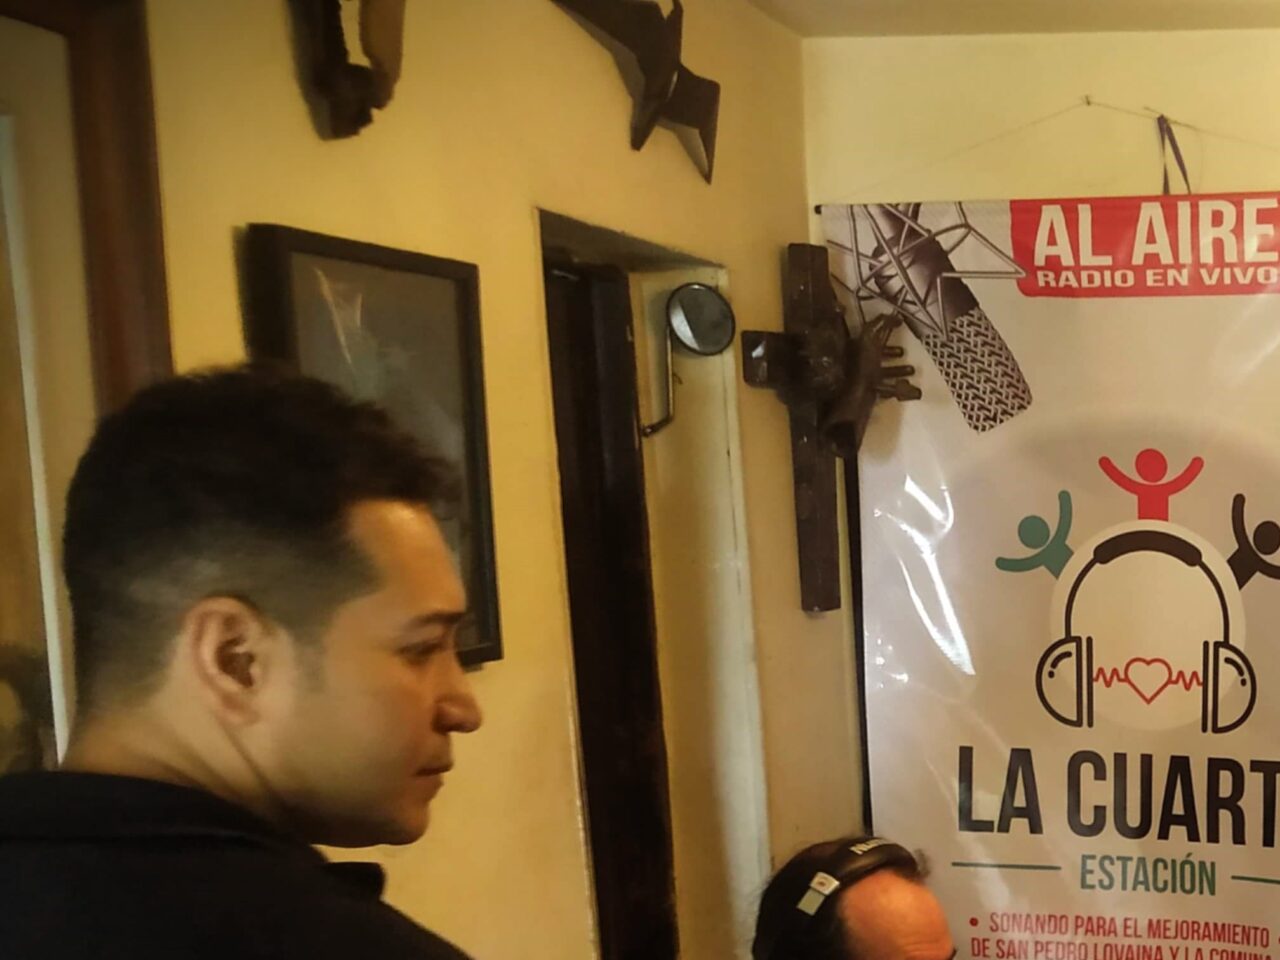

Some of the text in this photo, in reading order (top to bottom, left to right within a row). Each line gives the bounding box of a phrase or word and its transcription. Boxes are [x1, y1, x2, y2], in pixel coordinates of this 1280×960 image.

[1034, 198, 1279, 267] AL AIRE
[1037, 266, 1279, 288] RADIO EN VIVO
[957, 745, 1044, 835] LA
[1080, 852, 1217, 896] ESTACIÓN
[971, 937, 990, 958] DE
[995, 938, 1029, 960] SAN
[989, 912, 1270, 949] SONANDO PARA EL MEJORAMIENTO
